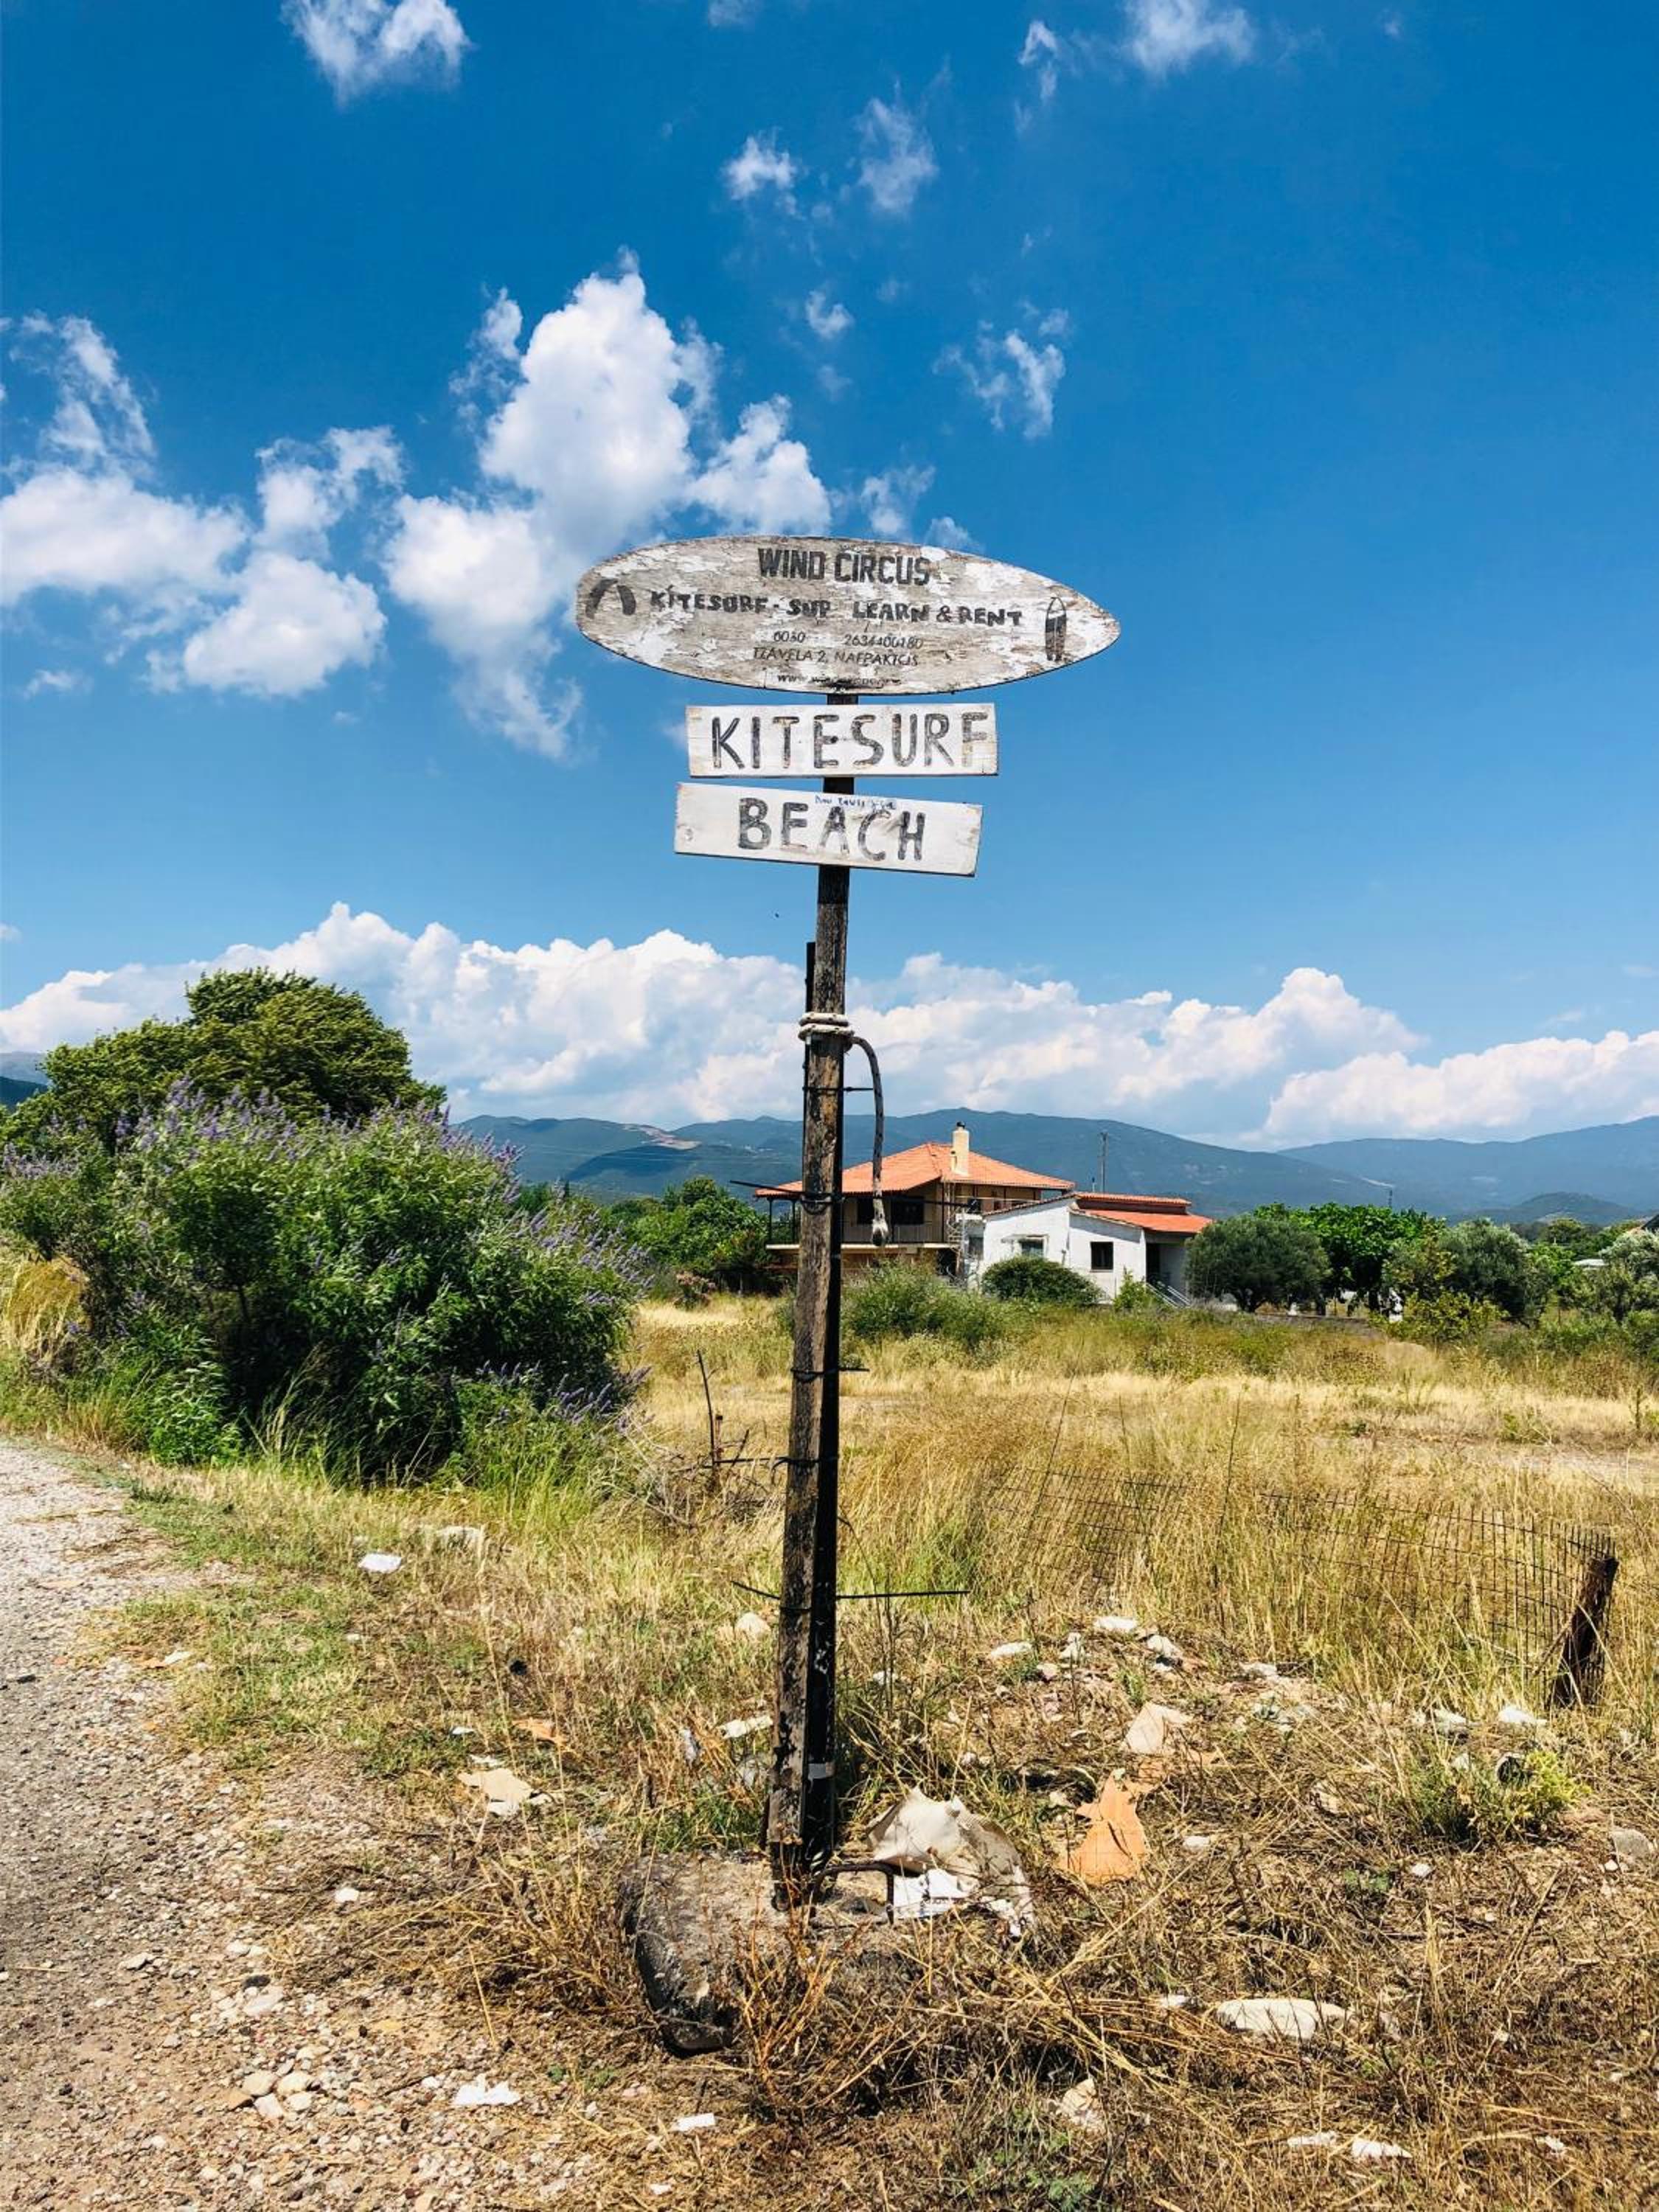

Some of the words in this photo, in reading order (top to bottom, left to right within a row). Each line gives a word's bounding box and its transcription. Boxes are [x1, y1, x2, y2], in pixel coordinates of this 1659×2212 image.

[757, 548, 826, 580] WIND
[834, 552, 931, 586] CIRCUS
[786, 597, 831, 619] SUP
[852, 601, 930, 622] LEARN
[959, 606, 1023, 627] RENT
[711, 712, 990, 769] KITESURF
[737, 797, 926, 862] BEACH
